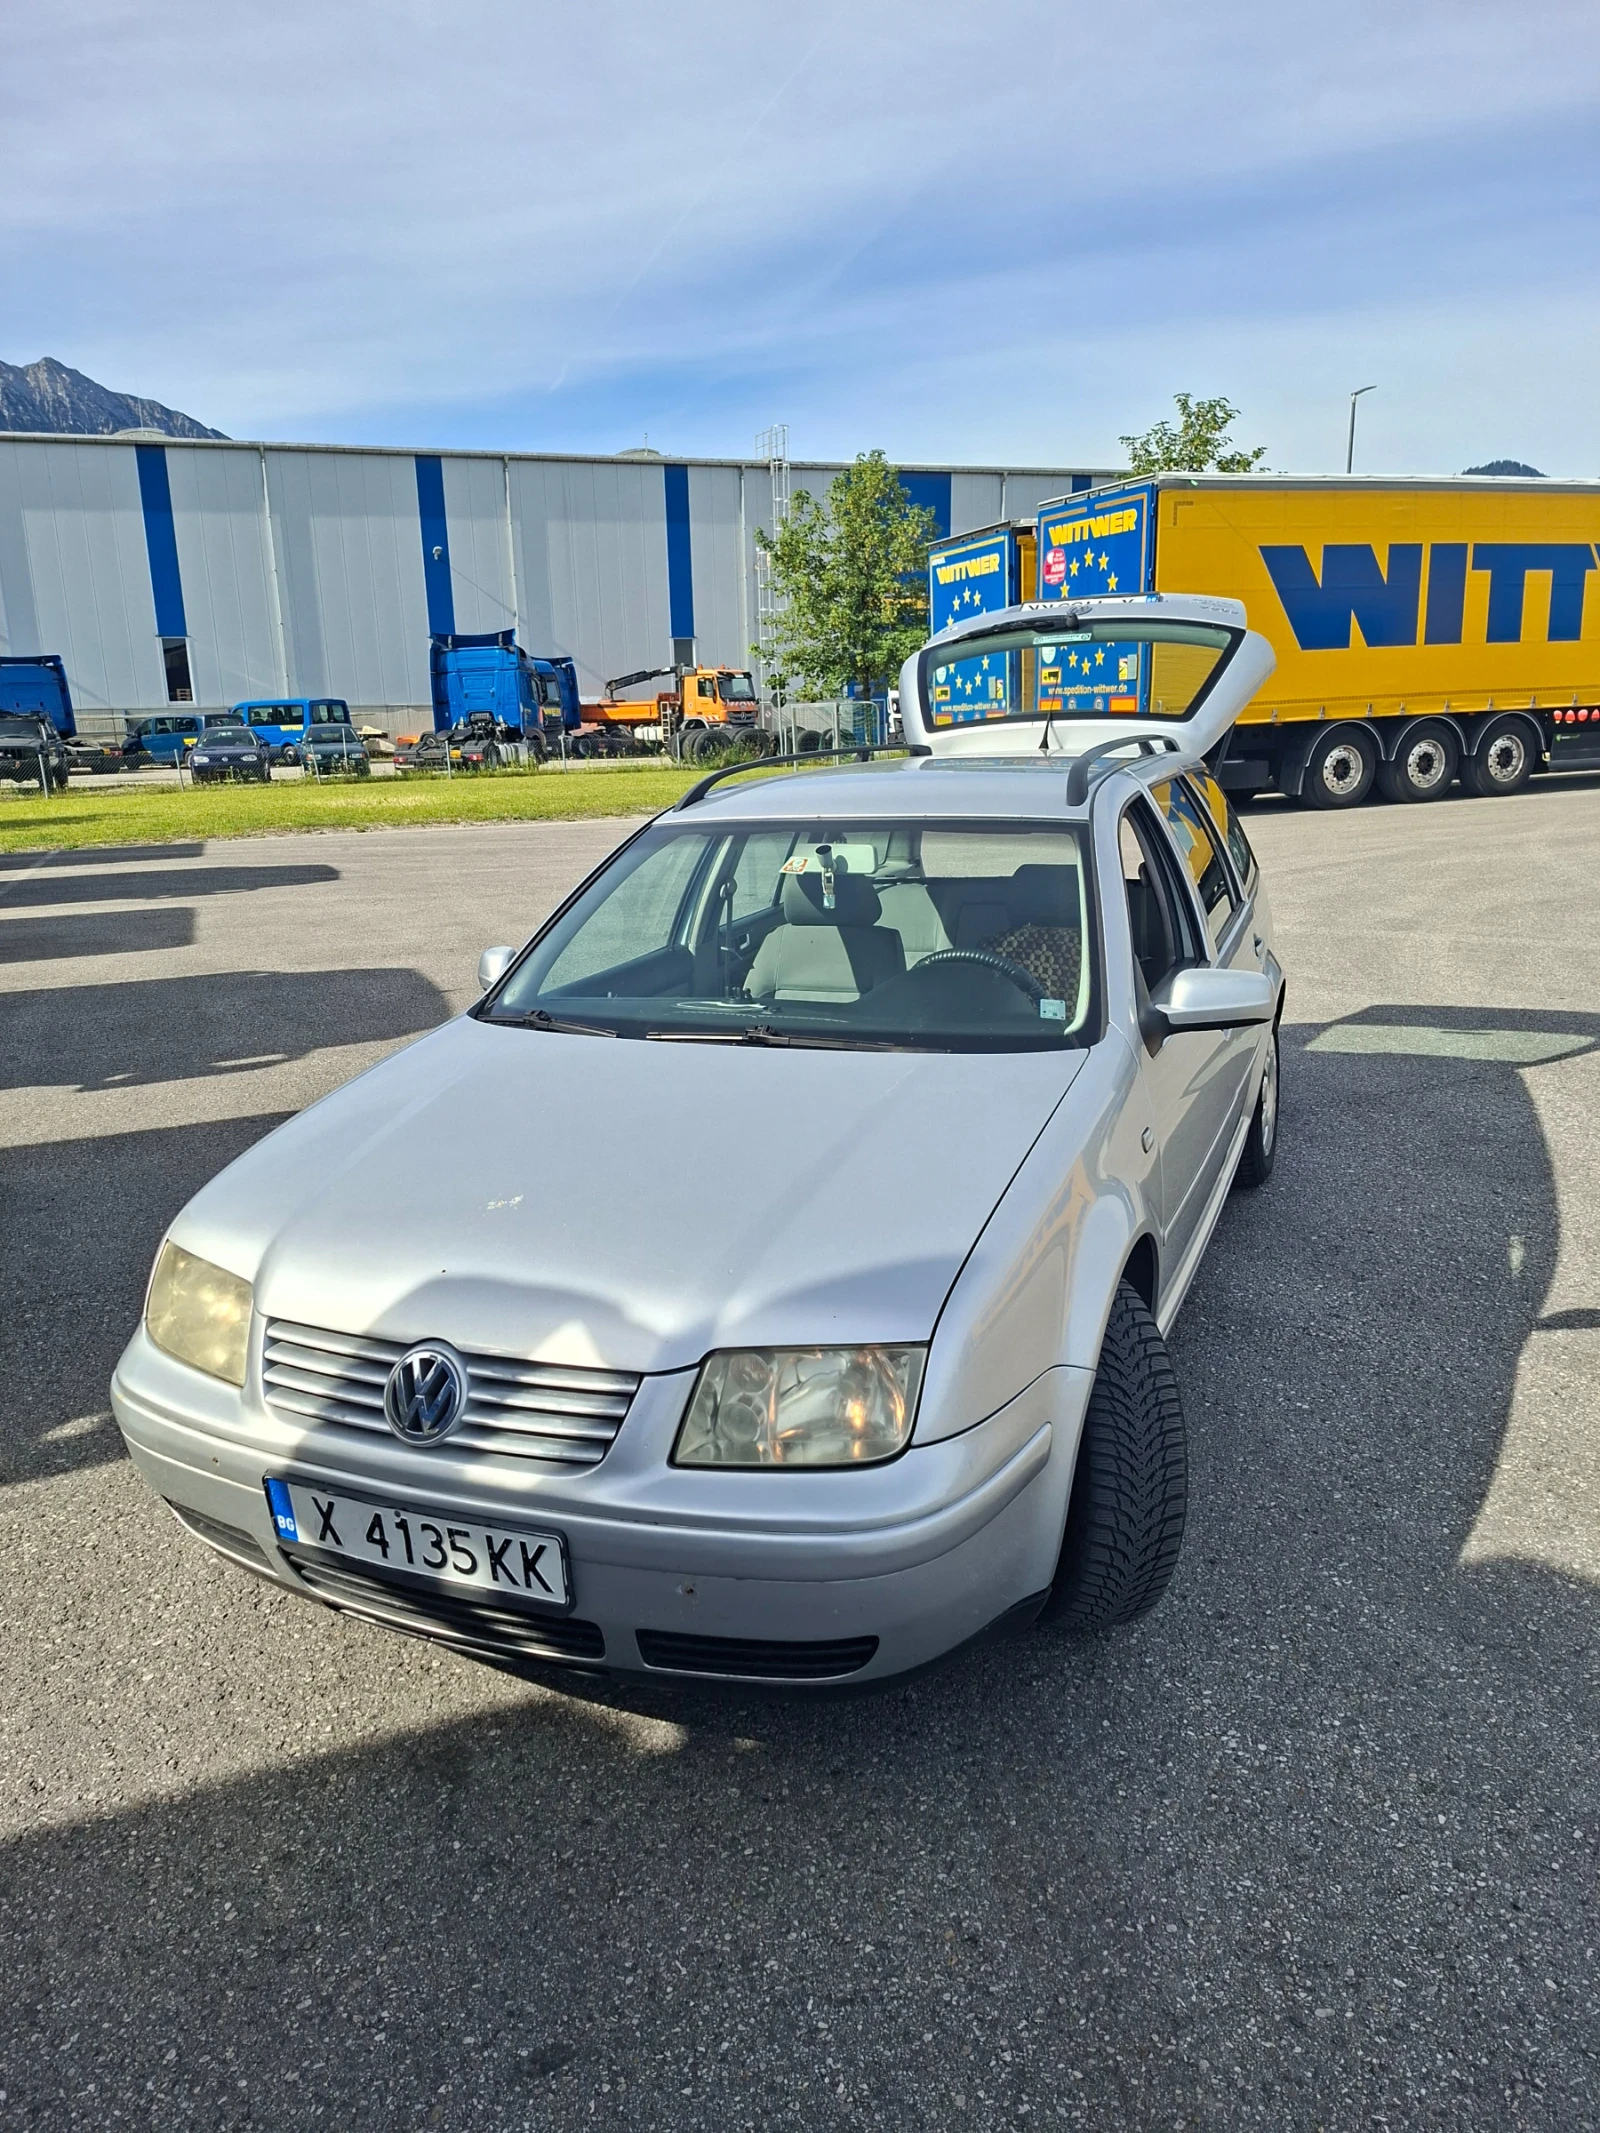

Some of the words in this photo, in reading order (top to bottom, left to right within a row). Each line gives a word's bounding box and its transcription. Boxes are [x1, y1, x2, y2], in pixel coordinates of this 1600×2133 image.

[1048, 508, 1138, 546] WITTWER
[936, 553, 1000, 585] WITTWER
[1258, 542, 1600, 651] WITT
[1048, 683, 1128, 696] www.spedition-wittwer.de
[392, 1350, 460, 1438] VW
[277, 1515, 295, 1530] BG
